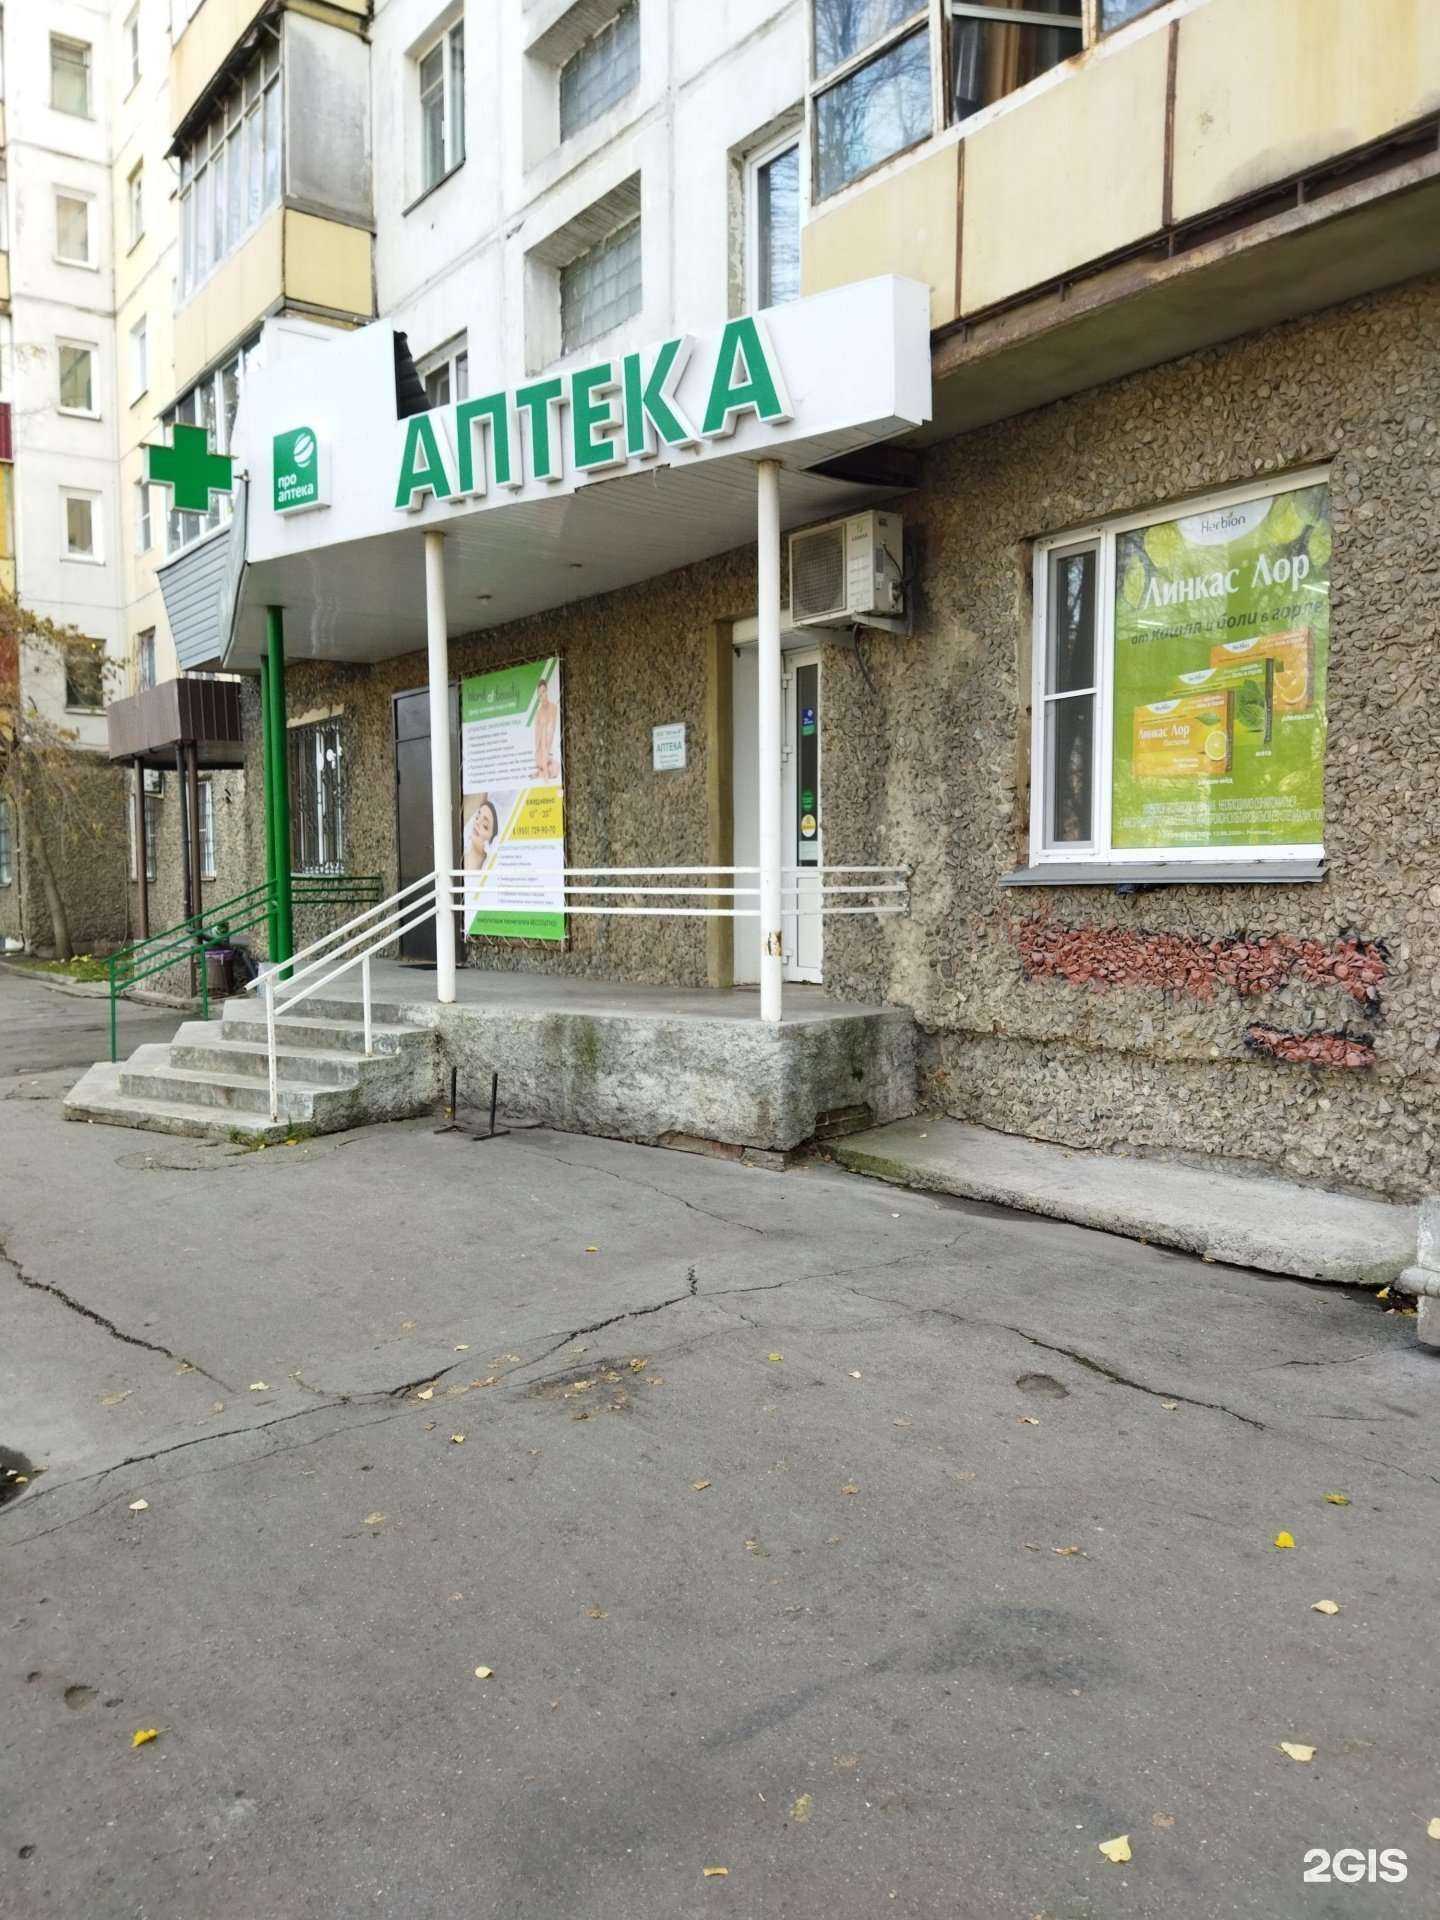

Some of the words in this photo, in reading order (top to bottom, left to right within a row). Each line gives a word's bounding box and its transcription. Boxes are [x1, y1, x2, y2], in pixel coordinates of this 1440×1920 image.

[395, 316, 792, 511] АПТЕКА
[277, 474, 297, 489] про
[277, 483, 315, 503] аптека
[1200, 513, 1247, 535] Herbion
[1143, 568, 1240, 610] Линкас
[1251, 553, 1311, 592] Лор
[1131, 634, 1150, 646] от
[1151, 621, 1203, 642] кашля
[1216, 609, 1258, 631] боли
[1260, 613, 1270, 623] в
[1271, 602, 1324, 622] горле
[1171, 724, 1190, 736] Лор
[656, 741, 682, 753] АПТЕКА
